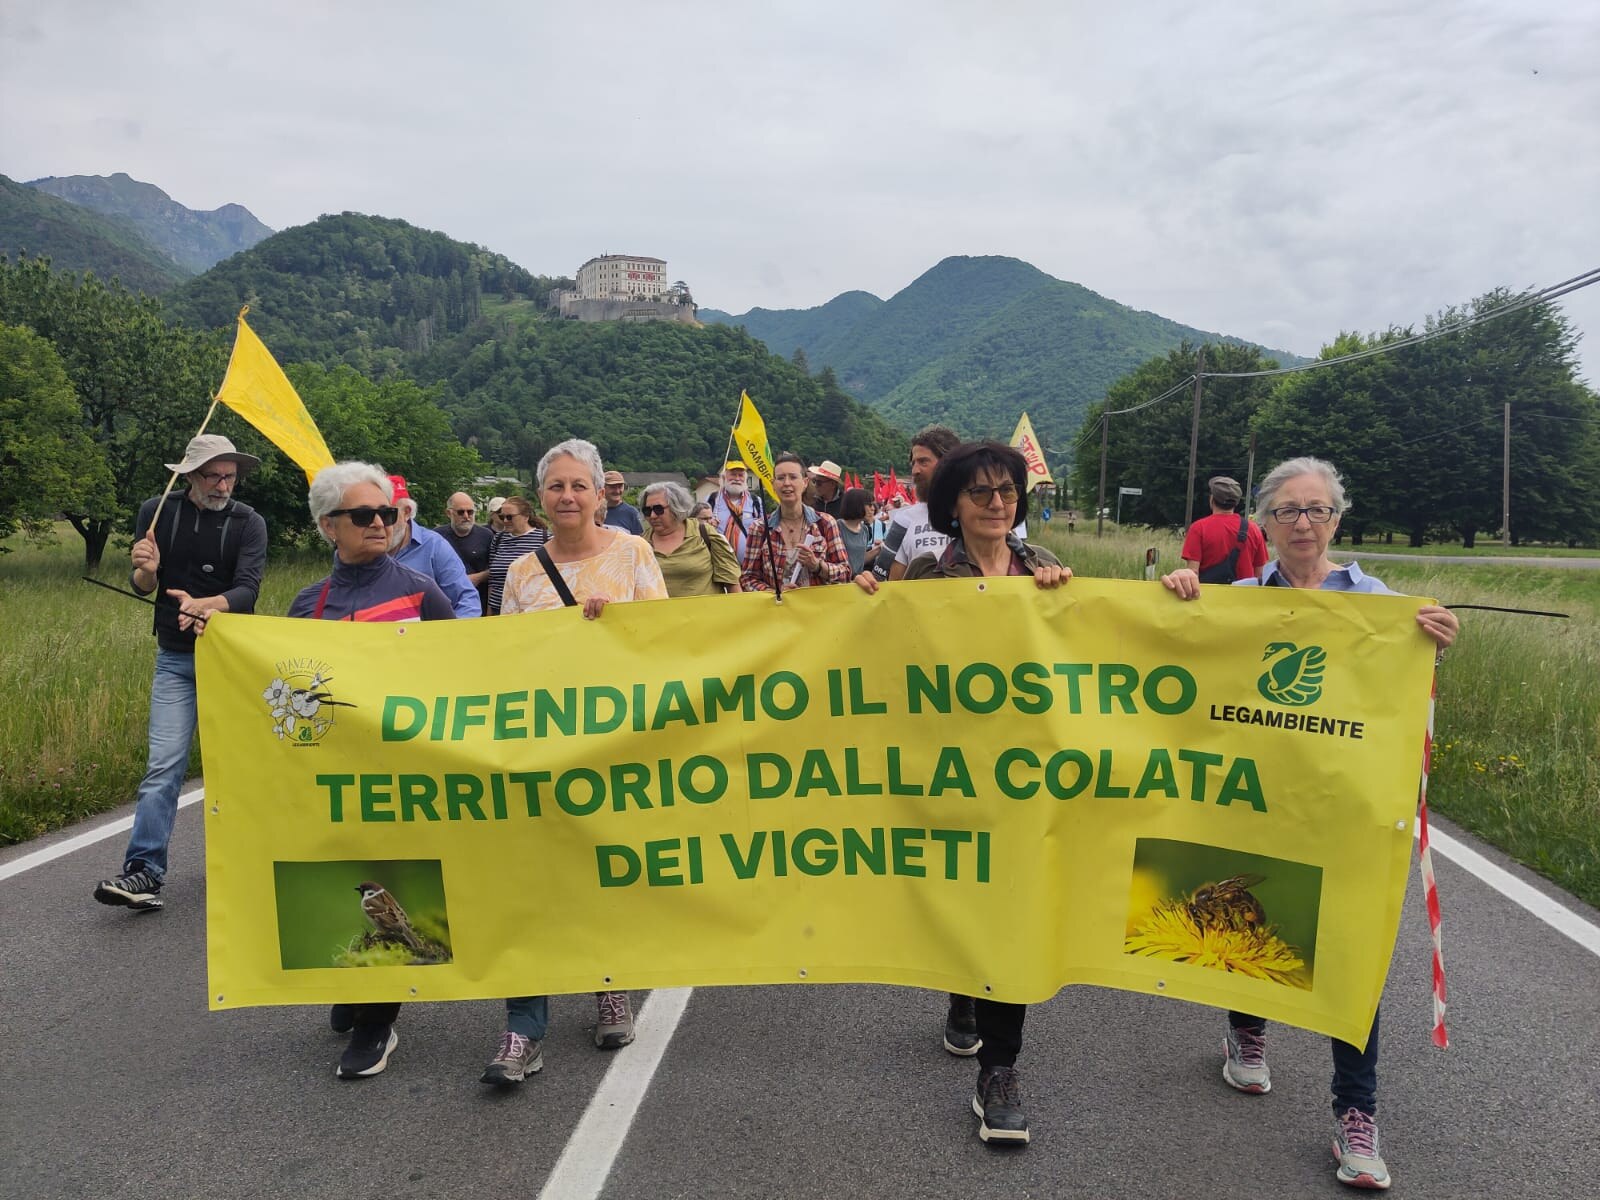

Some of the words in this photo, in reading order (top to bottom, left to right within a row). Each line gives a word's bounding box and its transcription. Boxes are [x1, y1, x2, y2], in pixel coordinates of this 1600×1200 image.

[914, 523, 934, 535] BA
[915, 536, 951, 549] PESTI
[381, 669, 811, 742] DIFENDIAMO
[828, 667, 888, 716] IL
[907, 662, 1197, 716] NOSTRO
[1210, 704, 1364, 739] LEGAMBIENTE
[315, 755, 729, 824] TERRITORIO
[746, 747, 976, 800] DALLA
[995, 747, 1267, 813] COLATA
[595, 837, 704, 888] DEI
[720, 828, 991, 884] VIGNETI
